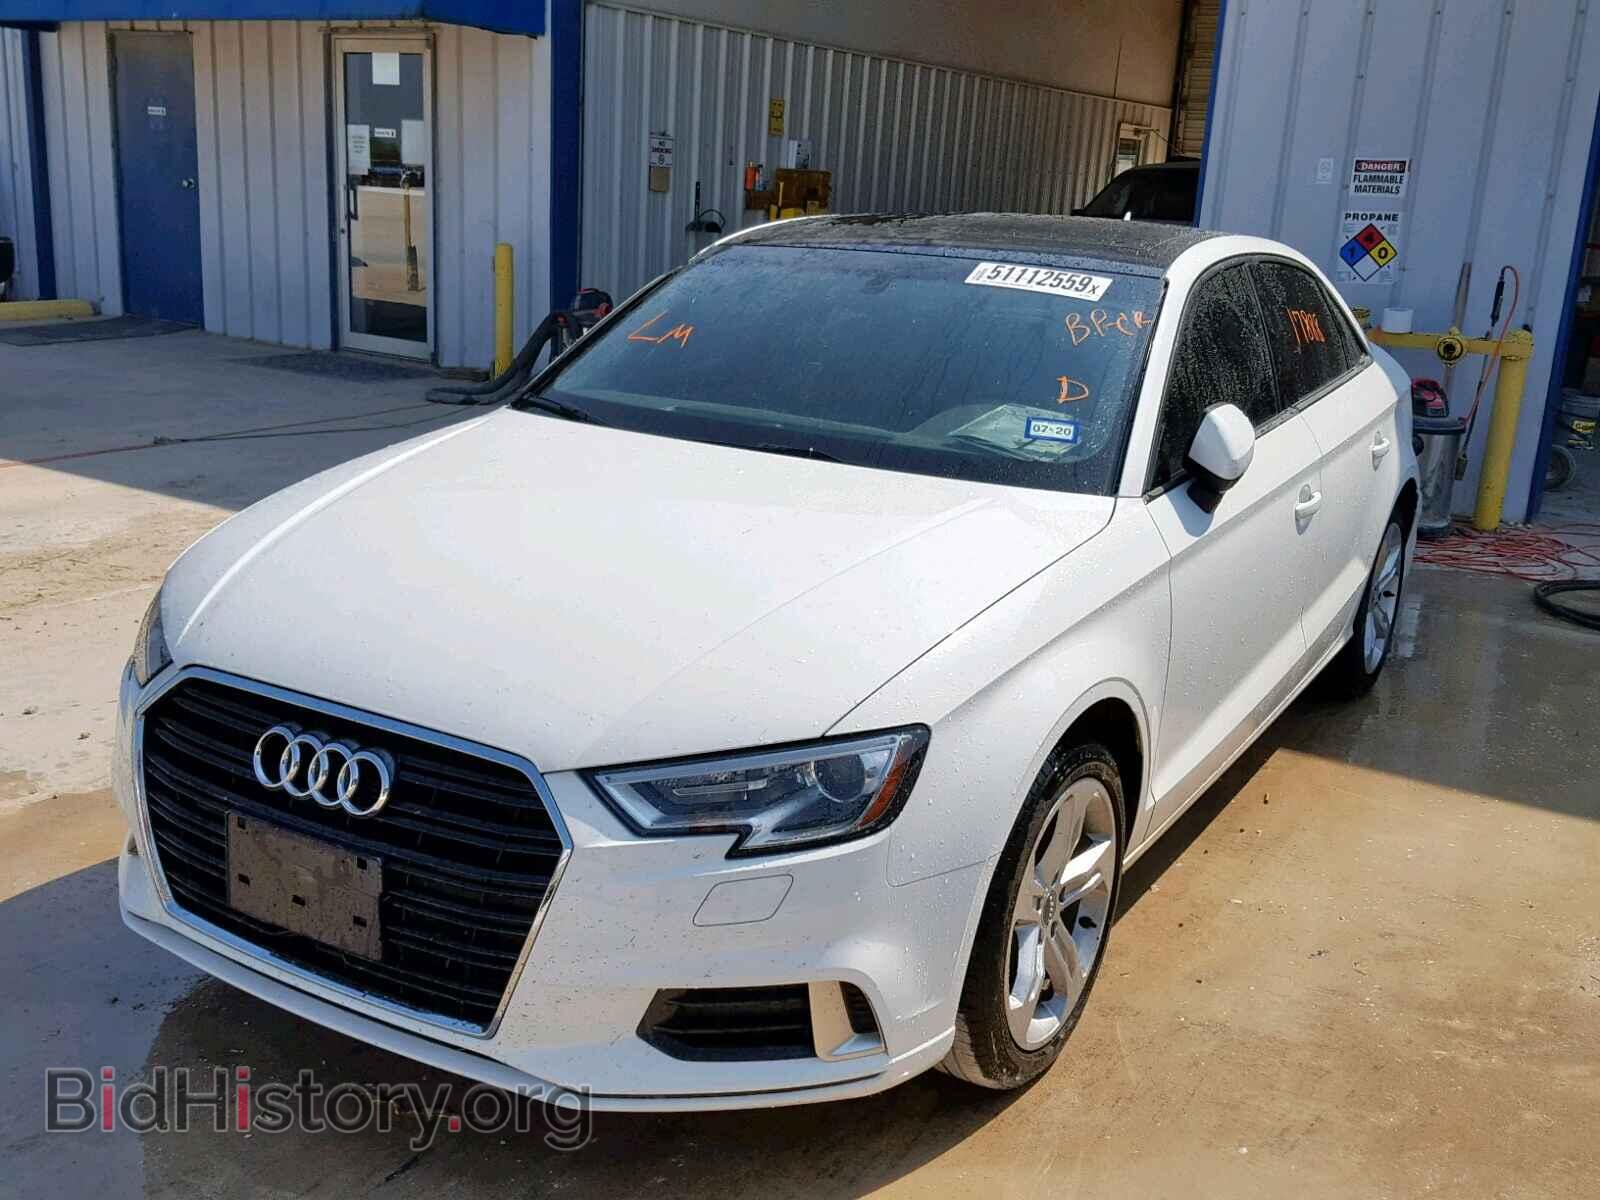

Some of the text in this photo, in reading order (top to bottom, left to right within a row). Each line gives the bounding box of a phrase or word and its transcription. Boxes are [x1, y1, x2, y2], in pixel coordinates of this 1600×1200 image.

[1360, 161, 1401, 171] DANGER
[1353, 174, 1404, 184] FLAMMABLE
[1354, 184, 1401, 195] MATERIALS
[1344, 212, 1399, 222] PROPANE
[1377, 247, 1389, 260] 0
[1056, 375, 1089, 404] D
